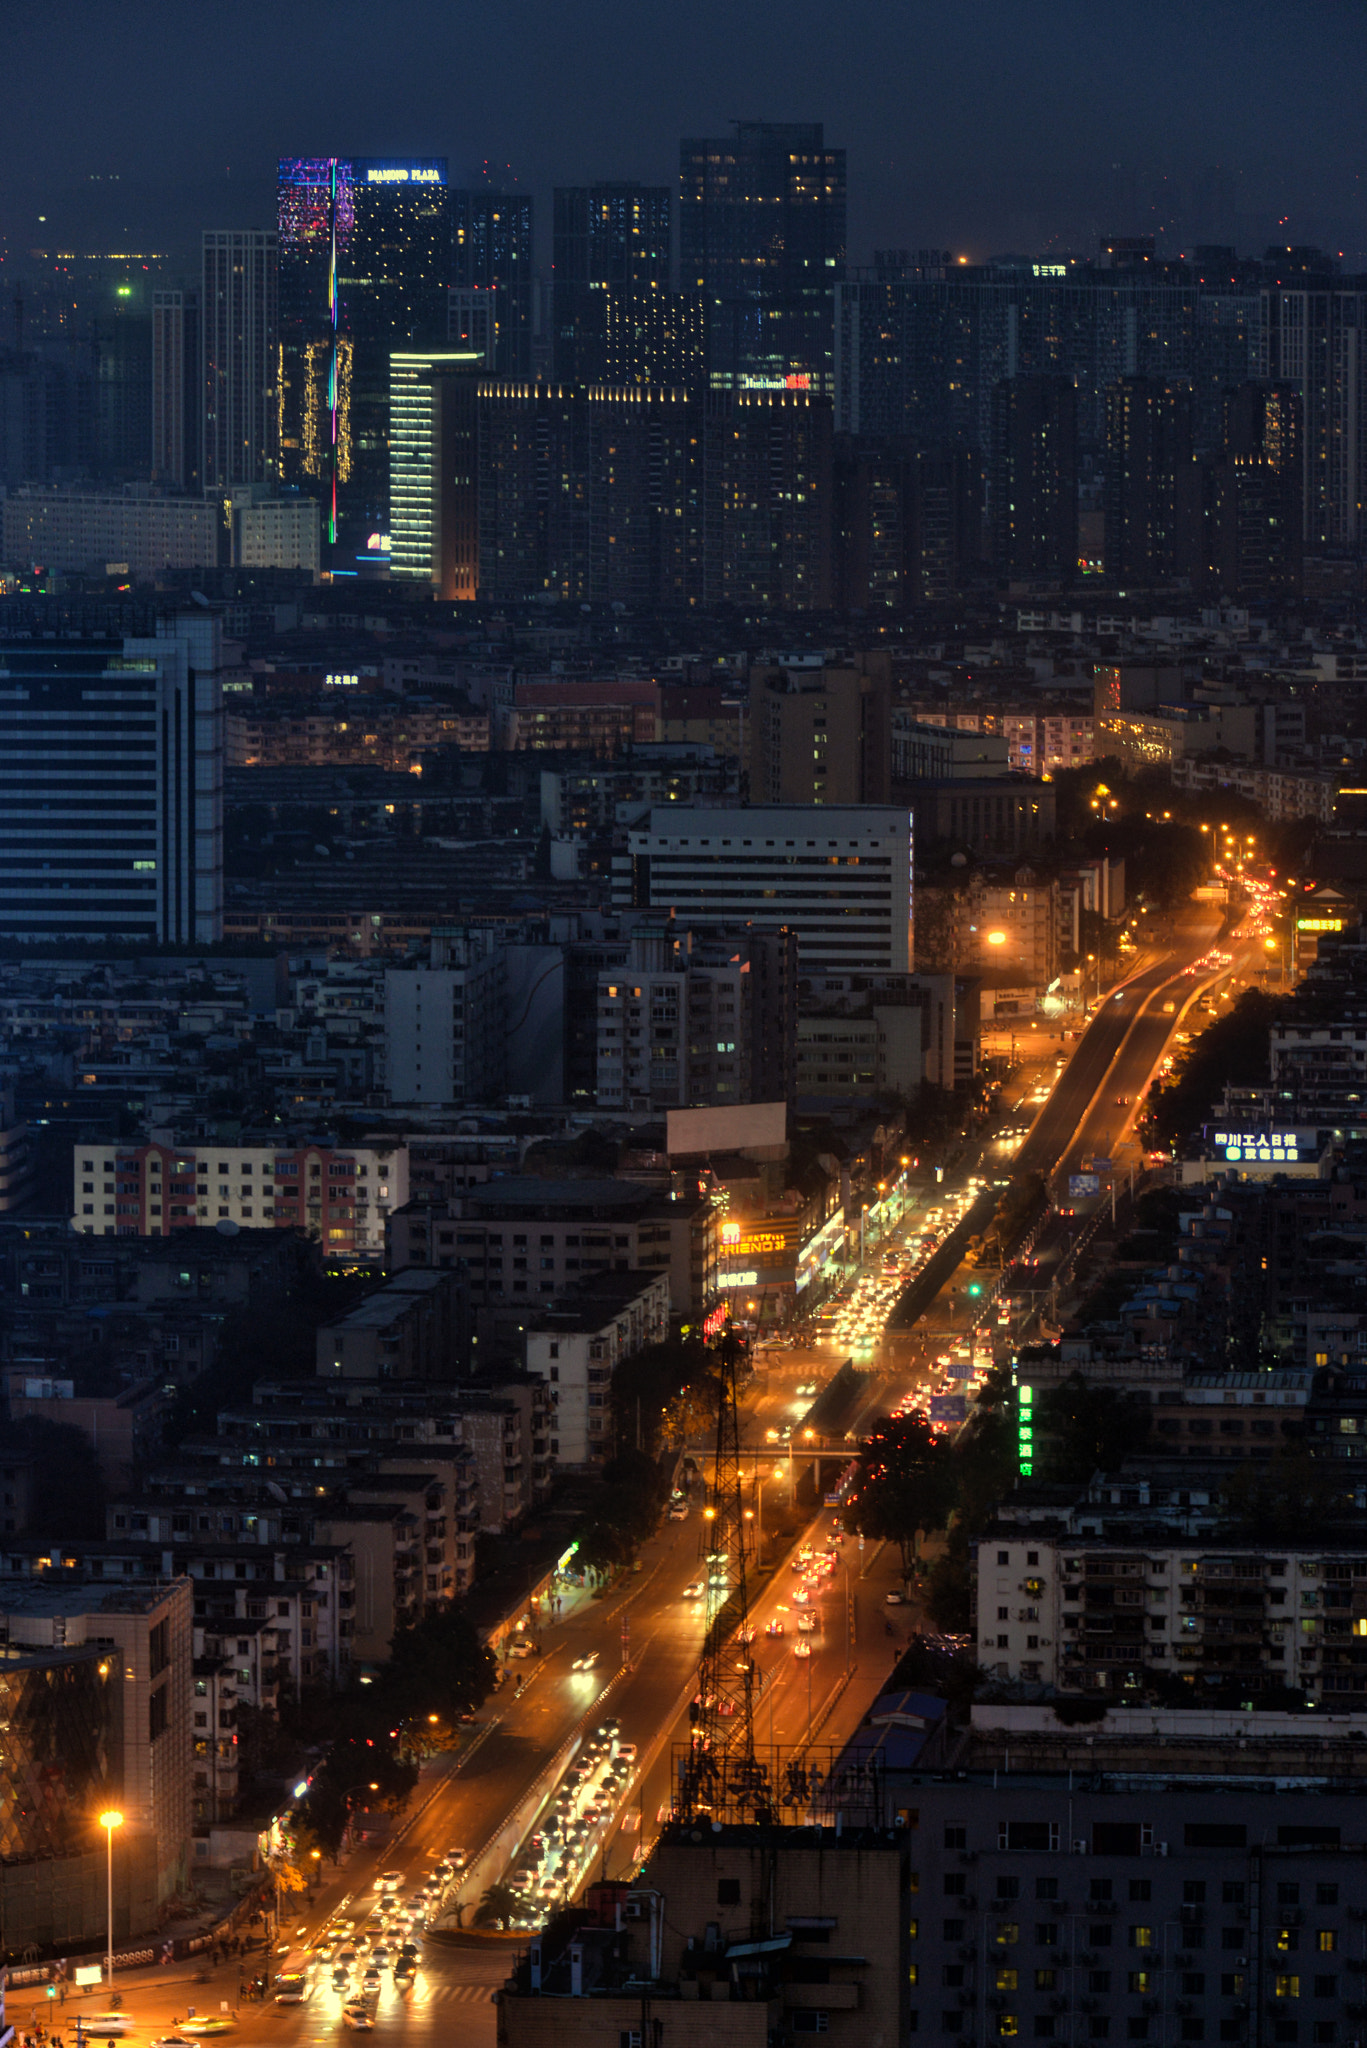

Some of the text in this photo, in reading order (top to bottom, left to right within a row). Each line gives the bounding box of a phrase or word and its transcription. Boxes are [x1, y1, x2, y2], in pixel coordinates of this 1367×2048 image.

[411, 169, 440, 181] PLAZA
[1214, 1133, 1297, 1147] 四川工人日报
